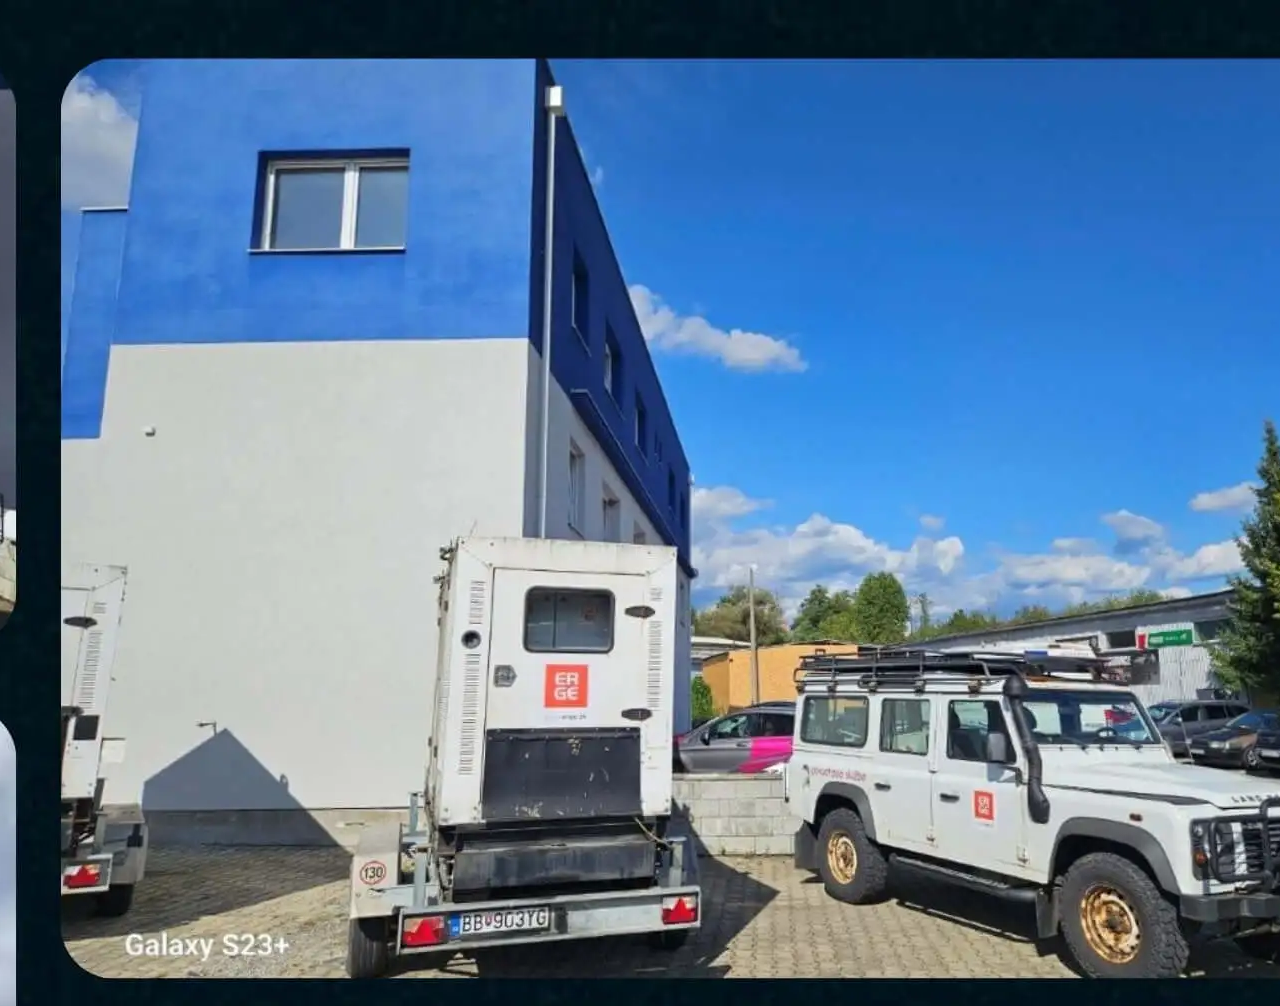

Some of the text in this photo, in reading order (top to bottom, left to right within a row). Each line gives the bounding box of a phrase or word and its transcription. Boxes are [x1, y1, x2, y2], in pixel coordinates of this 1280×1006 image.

[555, 672, 579, 685] ER
[554, 687, 580, 700] GE
[364, 867, 383, 879] 130
